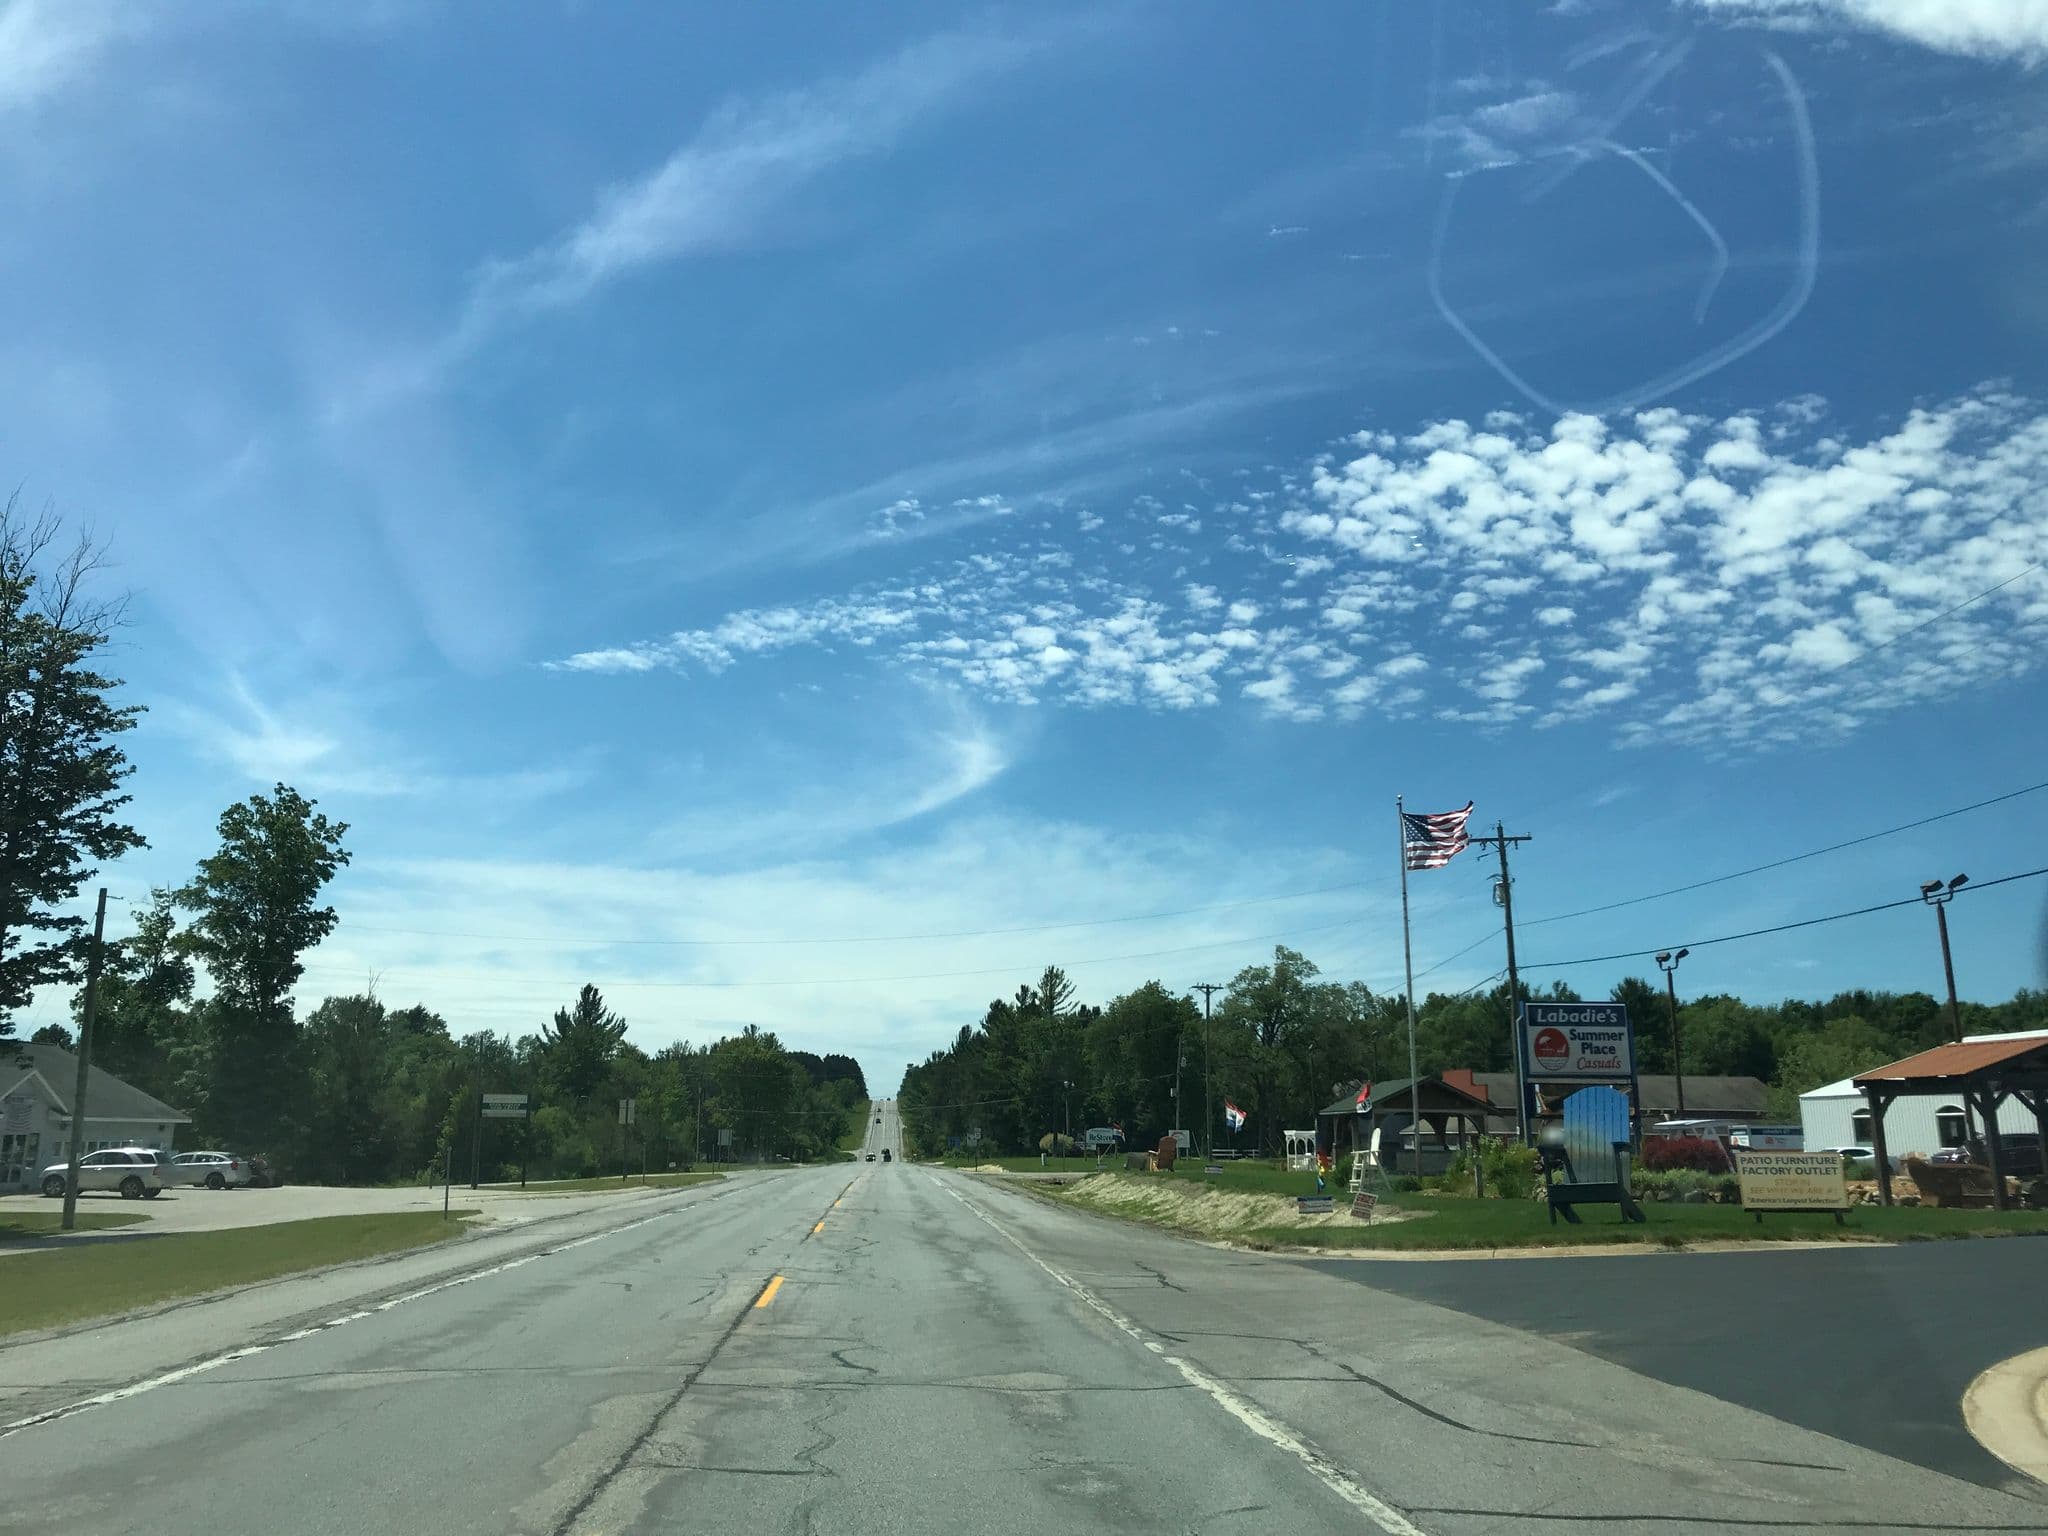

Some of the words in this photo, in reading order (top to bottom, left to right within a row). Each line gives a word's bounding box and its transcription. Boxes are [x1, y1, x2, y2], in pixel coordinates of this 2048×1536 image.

[1537, 1008, 1617, 1023] Labadie's
[1569, 1028, 1624, 1041] Summer
[1581, 1042, 1616, 1055] Place
[1576, 1056, 1621, 1070] Casuals
[1740, 1156, 1772, 1165] PATIO
[1775, 1156, 1837, 1165] FURNITURE
[1742, 1166, 1794, 1175] FACTORY
[1795, 1166, 1838, 1175] OUTLET
